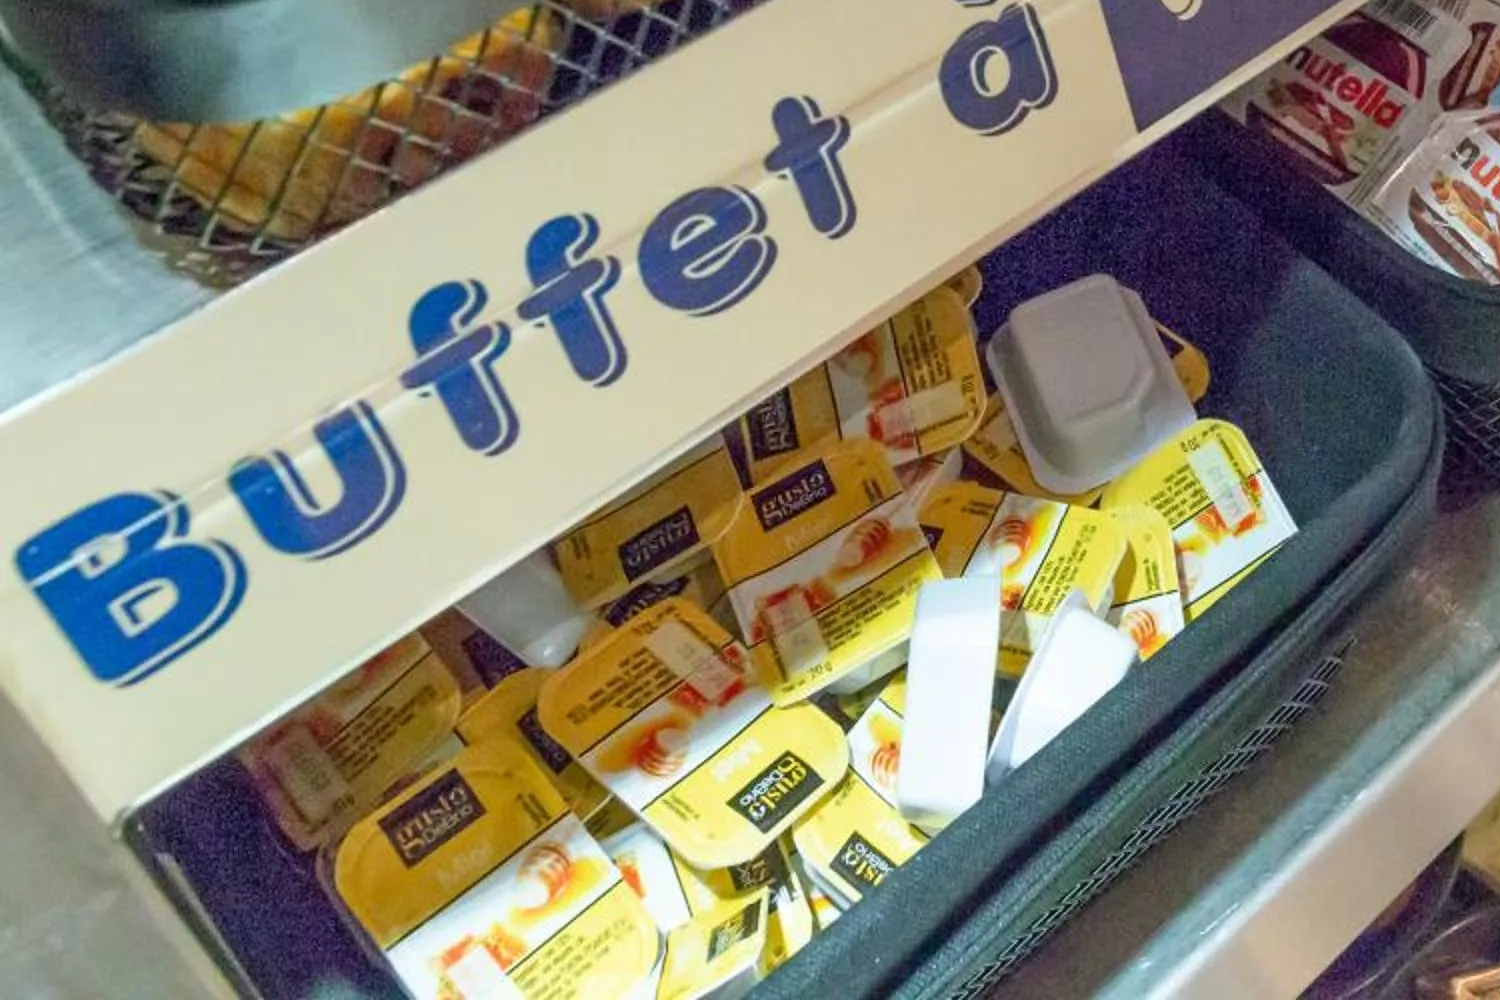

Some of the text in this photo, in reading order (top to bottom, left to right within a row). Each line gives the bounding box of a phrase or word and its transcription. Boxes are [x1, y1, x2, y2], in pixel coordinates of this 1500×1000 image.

[1284, 46, 1406, 130] nutella
[14, 94, 857, 688] Buffet
[762, 473, 824, 526] gusto
[739, 769, 784, 806] DeBrio
[749, 757, 807, 820] gusto
[396, 788, 467, 859] gusto
[423, 804, 473, 842] DeBrio
